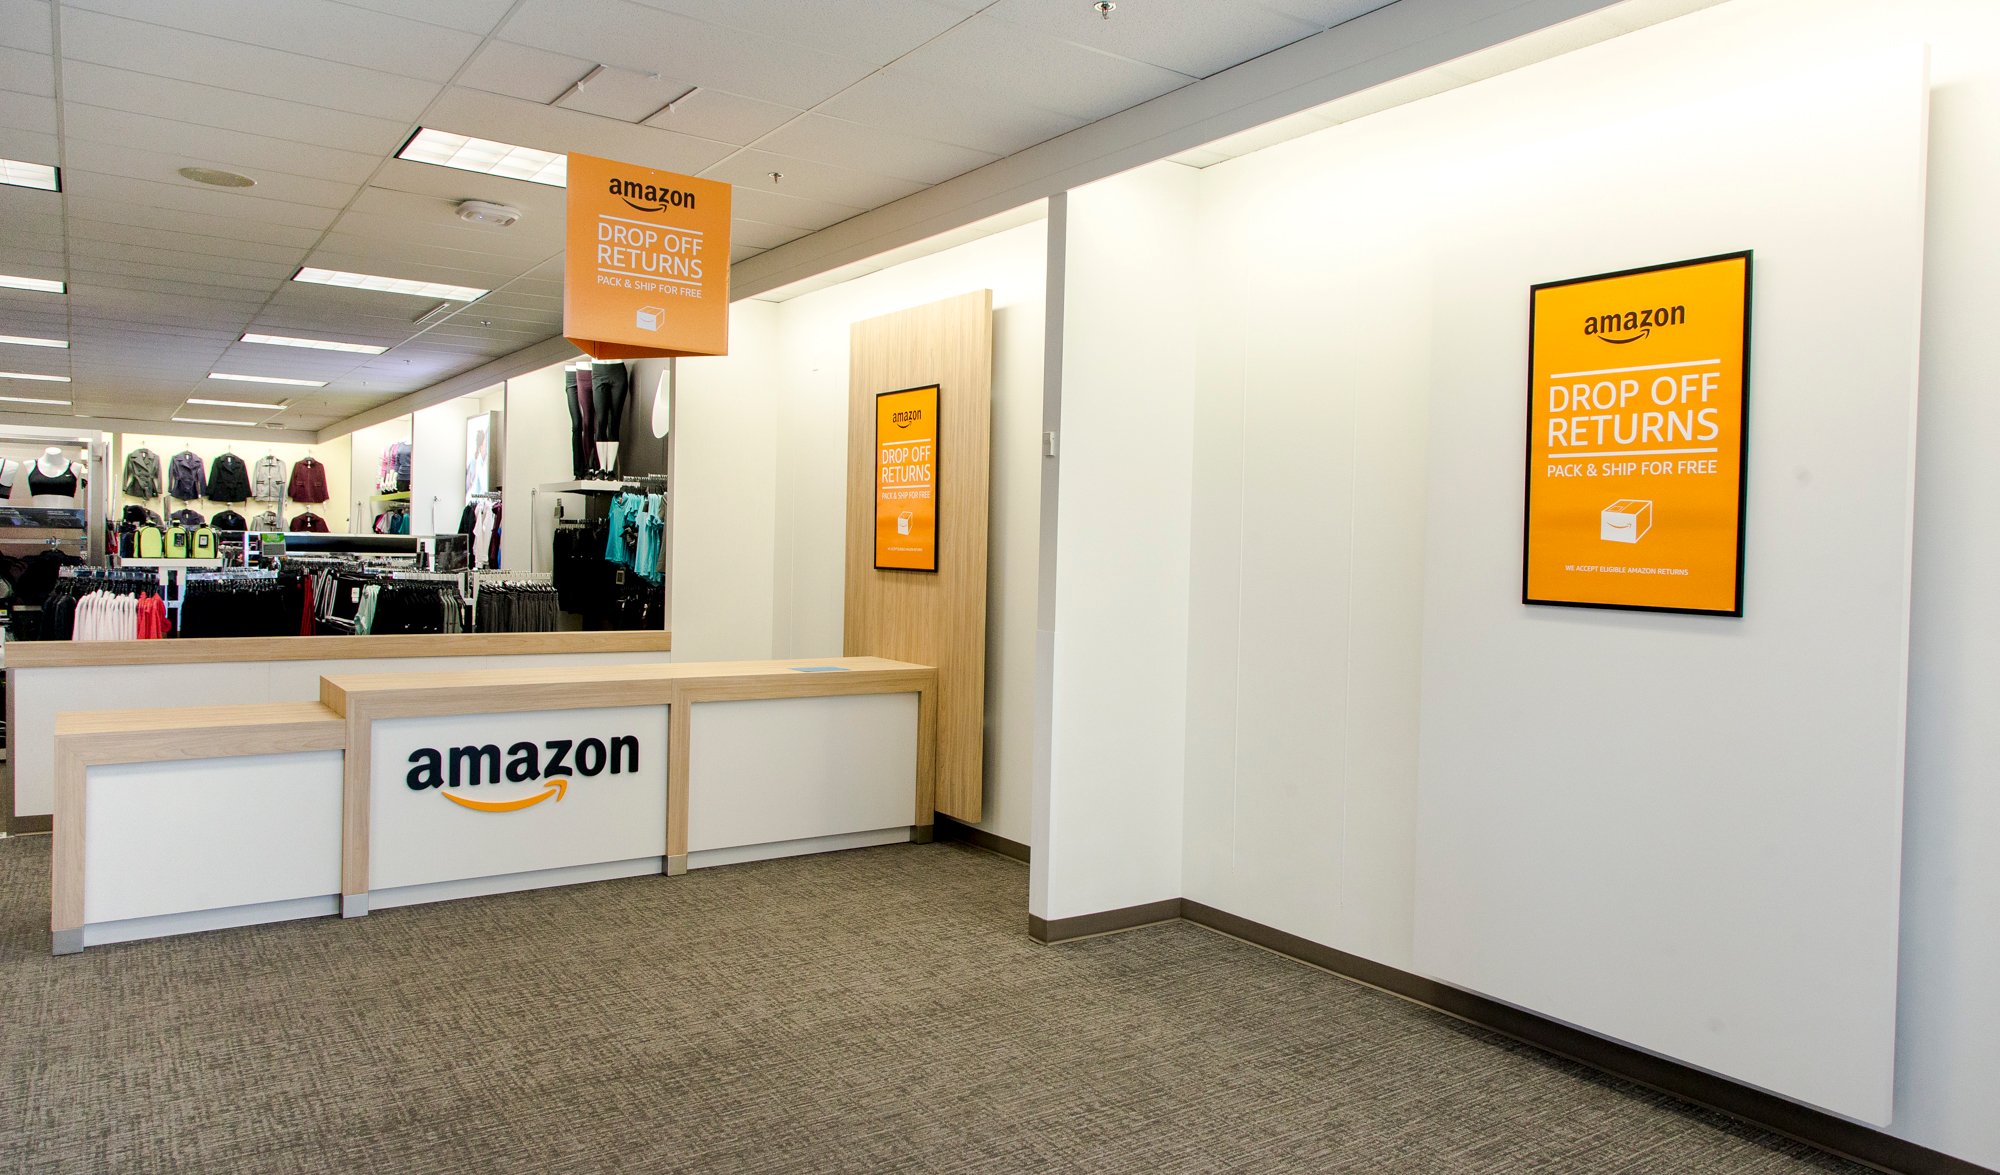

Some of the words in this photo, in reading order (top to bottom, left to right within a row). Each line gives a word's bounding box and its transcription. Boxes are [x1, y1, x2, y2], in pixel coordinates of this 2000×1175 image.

[609, 178, 695, 209] amazon
[598, 222, 658, 248] DROP
[664, 234, 703, 256] OFF
[597, 244, 703, 279] RETURNS
[597, 275, 622, 288] PACK
[624, 279, 632, 289] &
[635, 280, 656, 291] SHIP
[659, 284, 678, 295] FOR
[680, 287, 702, 299] FREE
[1584, 305, 1685, 335] amazon
[1550, 379, 1639, 413] DROP
[1651, 372, 1720, 406] OFF
[892, 409, 922, 423] amazon
[1548, 408, 1719, 447] RETURNS
[882, 447, 908, 464] DROP
[911, 445, 931, 462] OFF
[881, 464, 931, 483] RETURNS
[1547, 464, 1583, 478] PACK
[1586, 463, 1598, 477] &
[1602, 462, 1637, 476] SHIP
[1641, 461, 1673, 475] FOR
[1678, 459, 1718, 475] FREE
[898, 491, 909, 499] SHIP
[909, 491, 919, 499] FOR
[919, 490, 930, 499] FREE
[1599, 566, 1627, 574] ELIGIBLE
[1627, 567, 1657, 575] AMAZON
[1658, 568, 1689, 576] RETURNS
[406, 735, 639, 790] amazon
